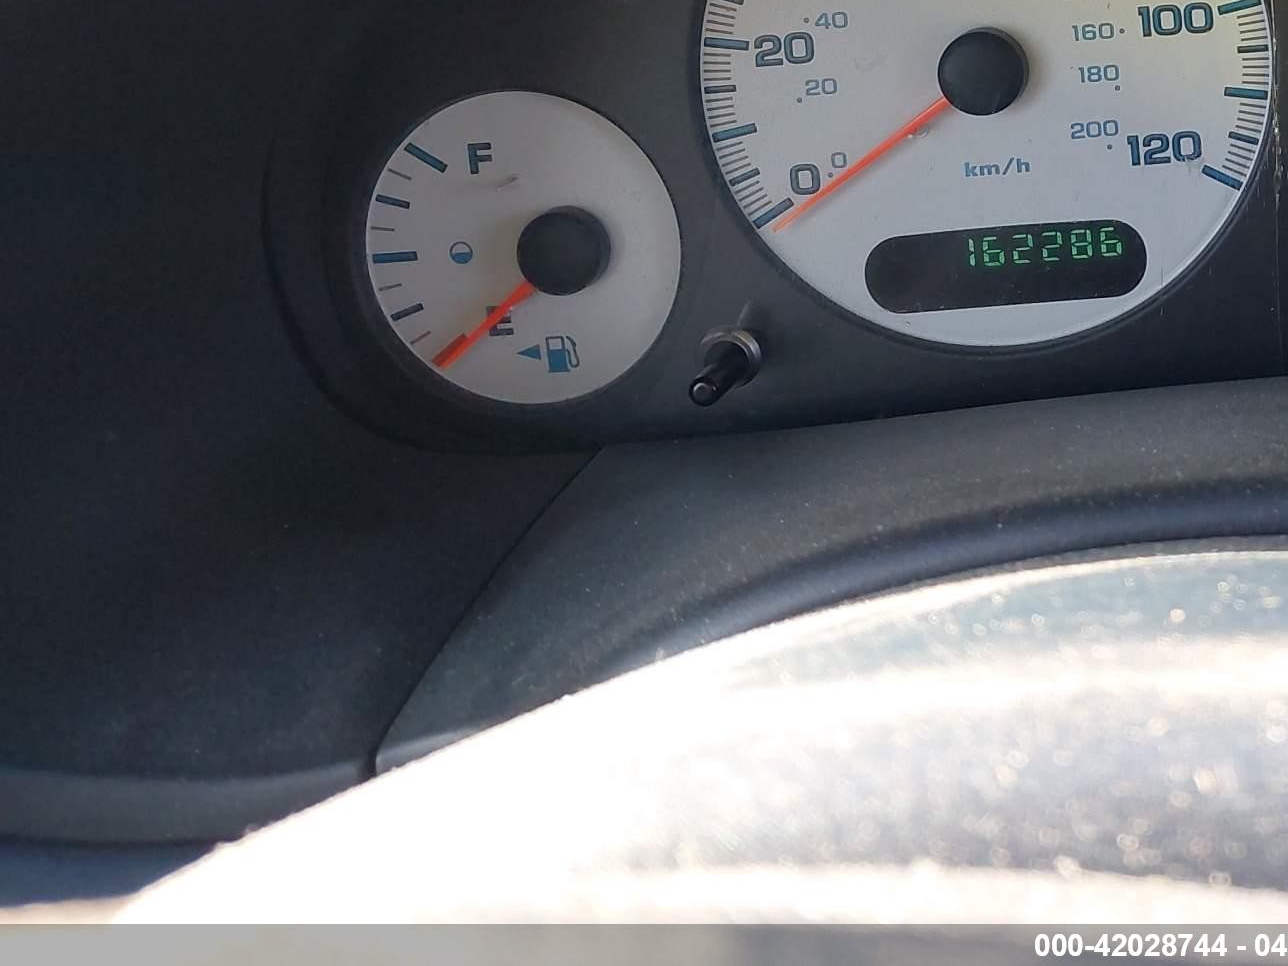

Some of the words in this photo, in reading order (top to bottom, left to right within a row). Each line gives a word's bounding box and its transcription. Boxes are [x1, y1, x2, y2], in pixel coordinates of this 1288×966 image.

[815, 12, 848, 29] 40
[1072, 22, 1115, 41] 160
[1138, 2, 1214, 37] 100
[753, 32, 815, 67] 20
[1078, 65, 1120, 83] 180
[806, 78, 838, 96] 20
[1070, 120, 1119, 139] 200
[467, 142, 493, 175] F
[831, 152, 847, 169] 0
[1127, 131, 1202, 167] 120
[789, 164, 820, 195] 0
[964, 157, 1031, 177] km/h
[968, 227, 1122, 267] 162286
[486, 305, 514, 336] E
